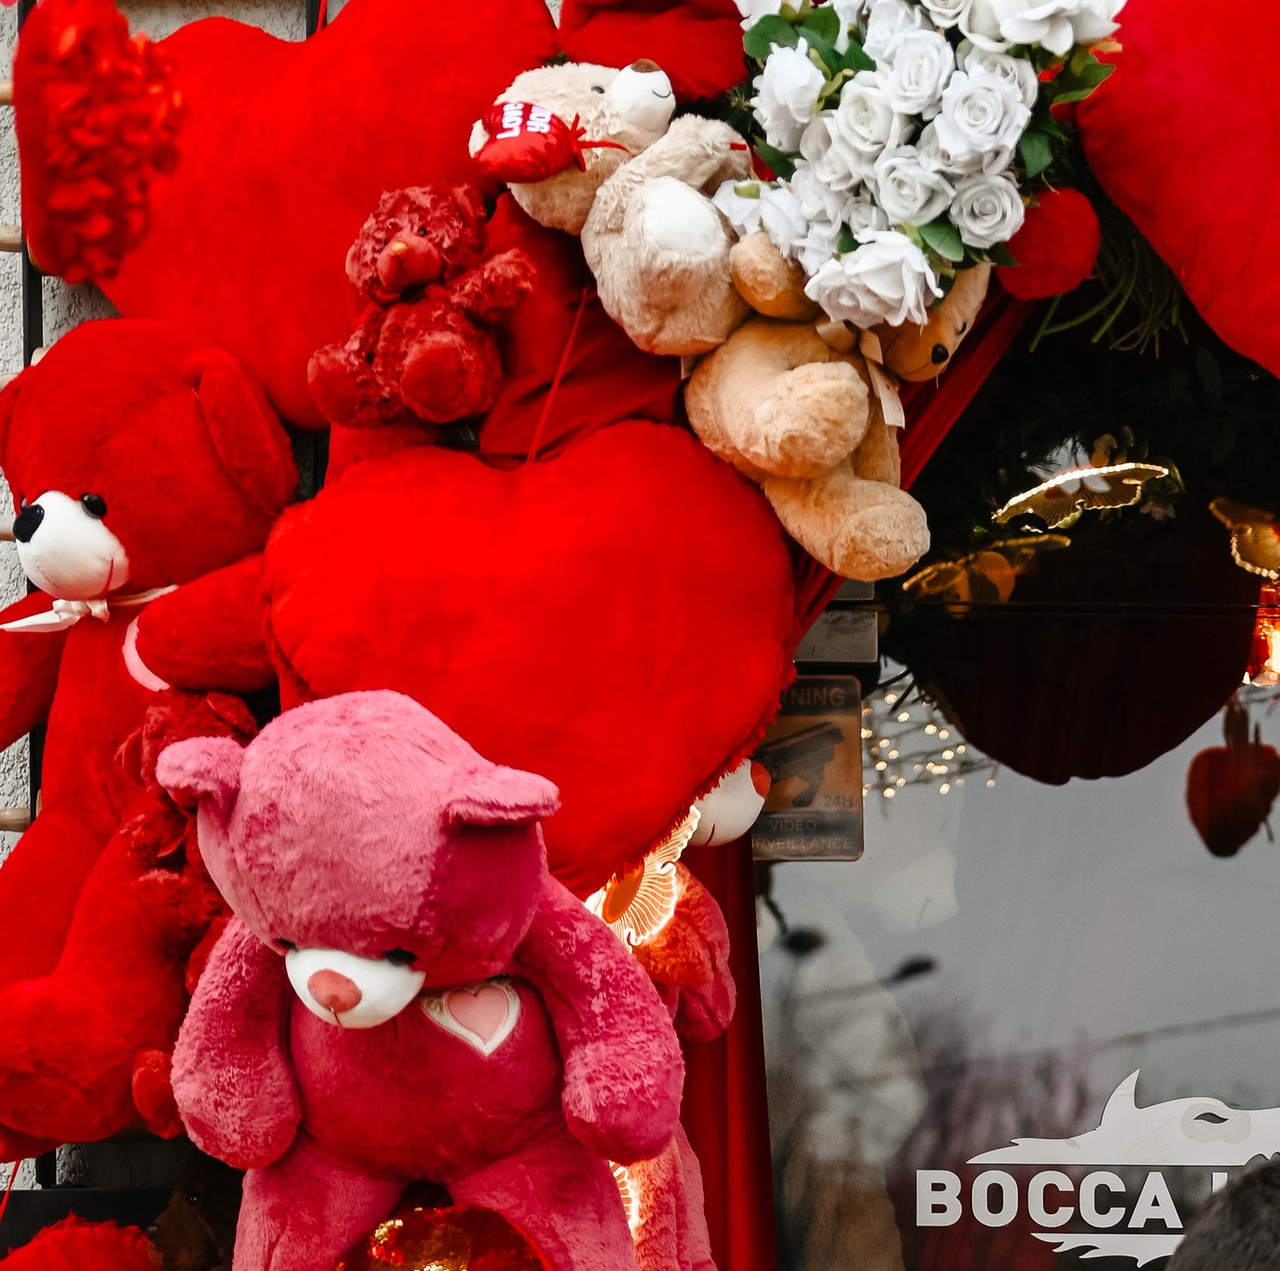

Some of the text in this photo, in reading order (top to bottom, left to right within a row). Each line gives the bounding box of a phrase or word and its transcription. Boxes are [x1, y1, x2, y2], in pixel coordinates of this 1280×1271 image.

[780, 687, 846, 706] RNING
[823, 795, 853, 808] 24H
[769, 819, 817, 833] VIDEO
[752, 836, 854, 851] RVEILLANCE
[915, 1169, 1183, 1228] BOCCA
